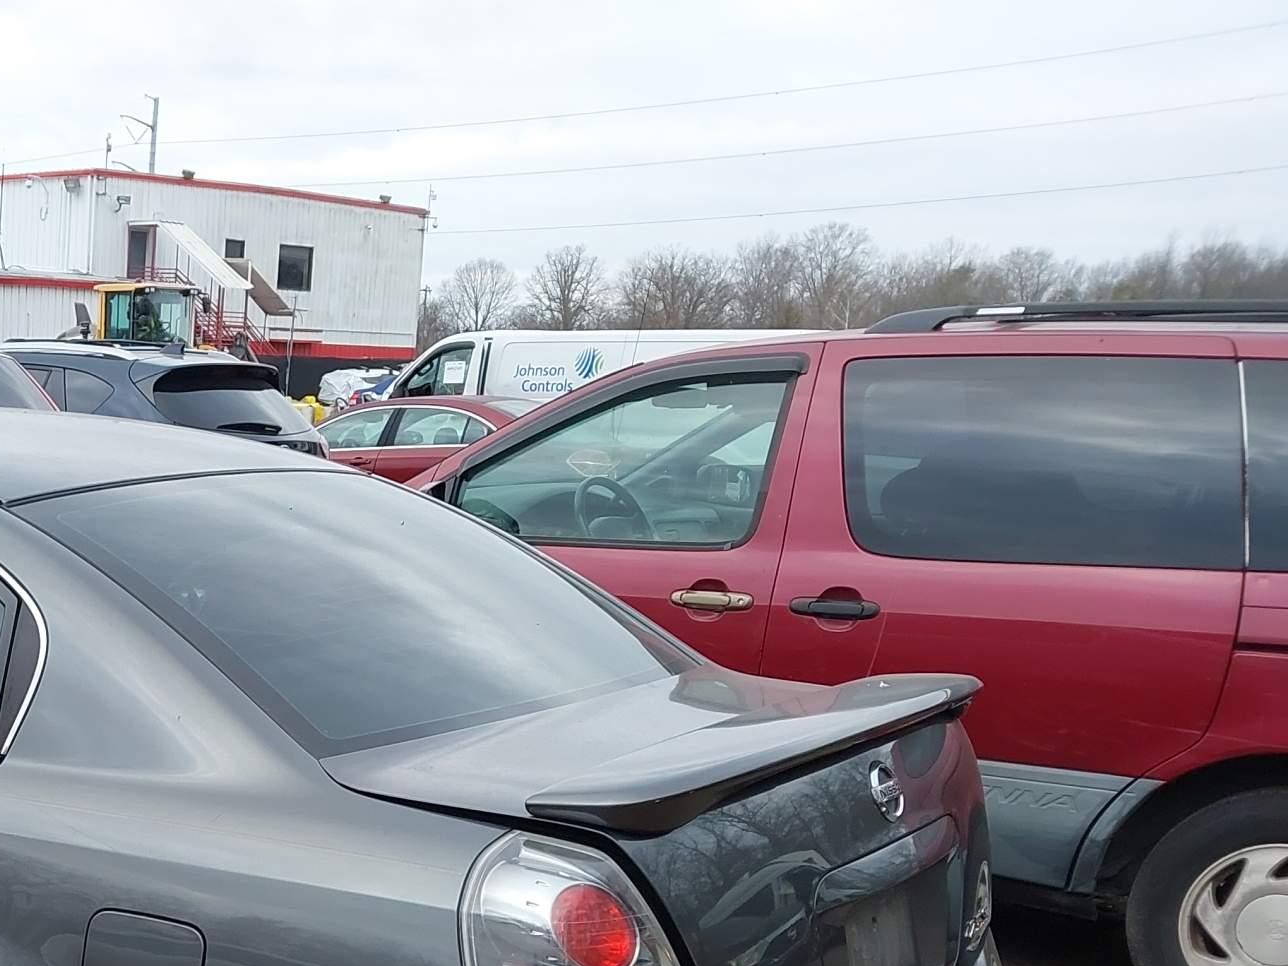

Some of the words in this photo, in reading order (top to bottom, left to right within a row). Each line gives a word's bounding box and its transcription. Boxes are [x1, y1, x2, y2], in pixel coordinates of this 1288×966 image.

[513, 363, 565, 378] Johnson
[521, 378, 573, 392] Controls
[983, 784, 1080, 814] NNA
